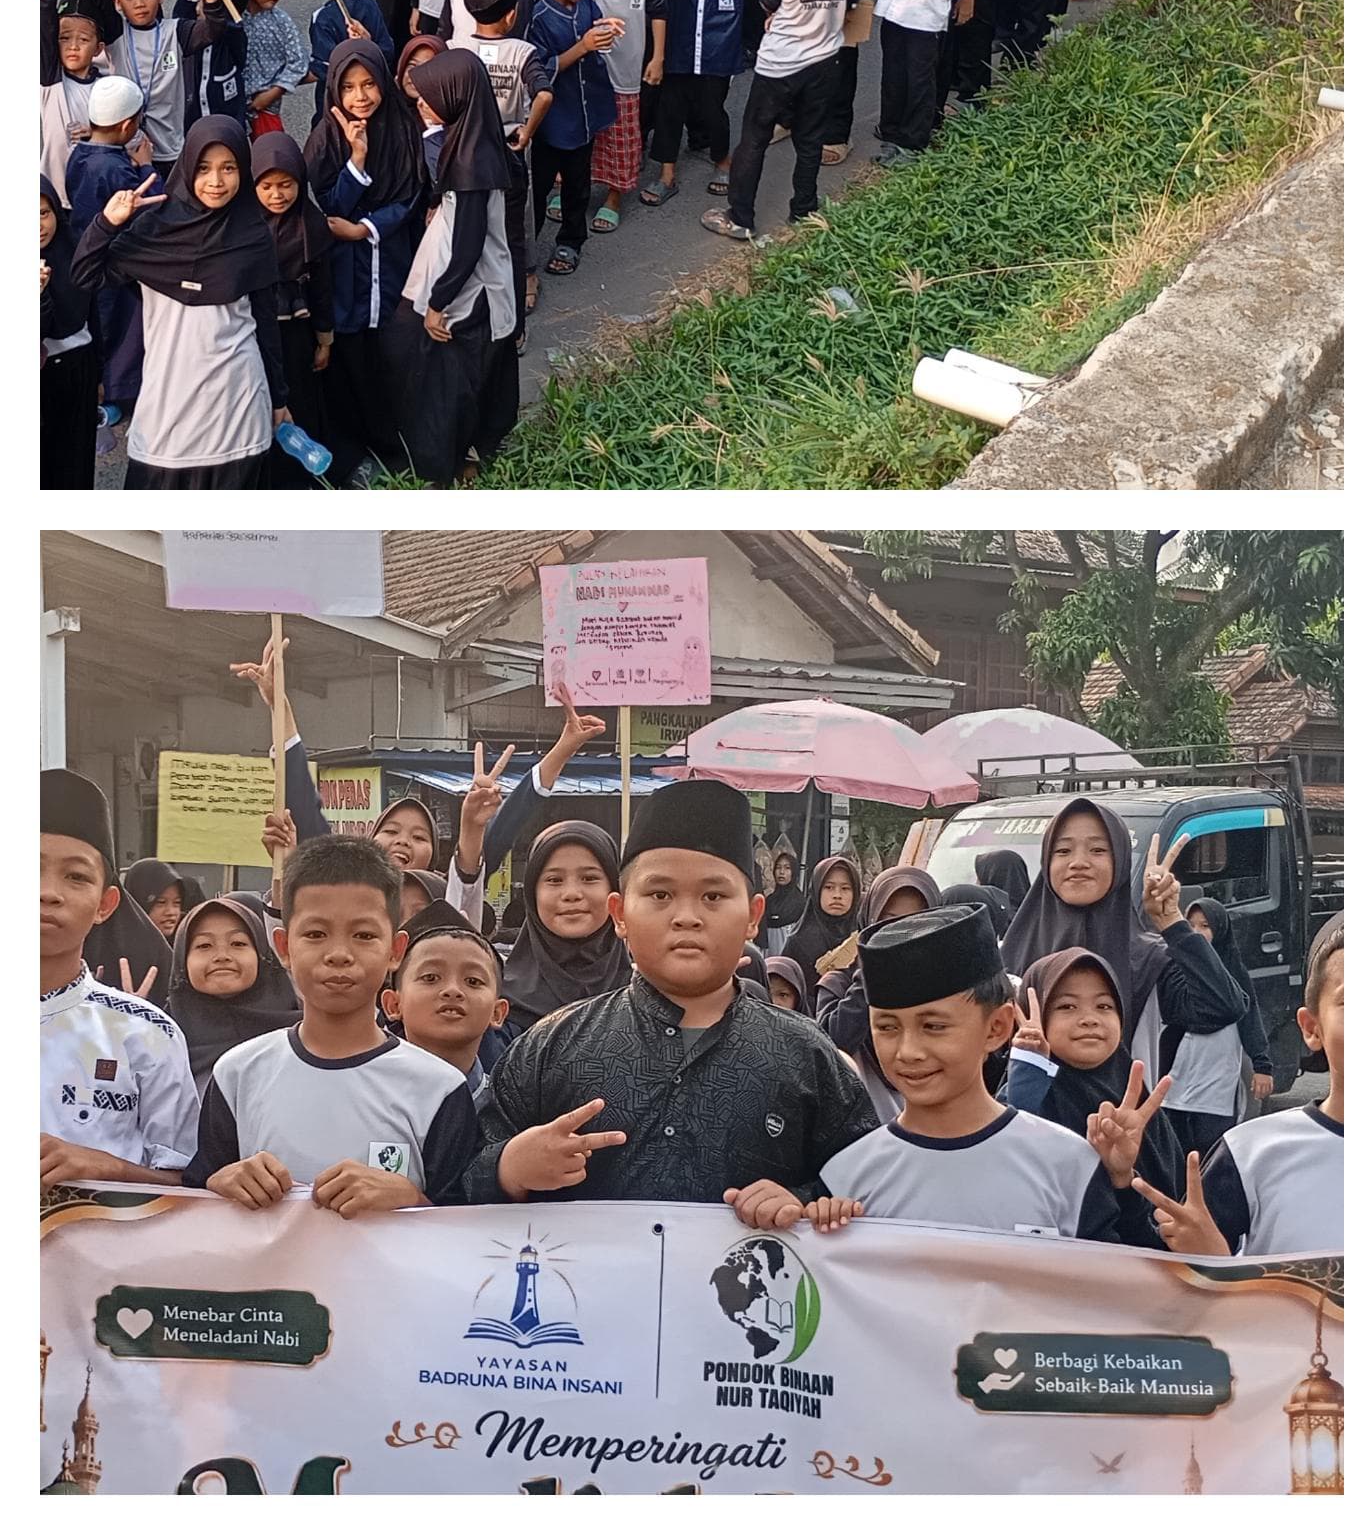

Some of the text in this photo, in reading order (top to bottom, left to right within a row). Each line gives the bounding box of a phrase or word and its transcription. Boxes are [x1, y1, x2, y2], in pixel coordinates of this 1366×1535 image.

[162, 1304, 284, 1324] Menebar Cinta
[162, 1326, 300, 1349] Meneladani Nabi
[476, 1356, 568, 1373] YAYASAN
[1034, 1351, 1183, 1374] Berbagi Kebaikan
[418, 1370, 623, 1396] BADRUNA BINA INSANI
[703, 1360, 834, 1397] PONDOK BINAAN
[1034, 1375, 1214, 1397] Sebaik-Baik Manusia
[716, 1384, 823, 1420] NUR TAQIYAH
[474, 1409, 787, 1480] Memperingati
